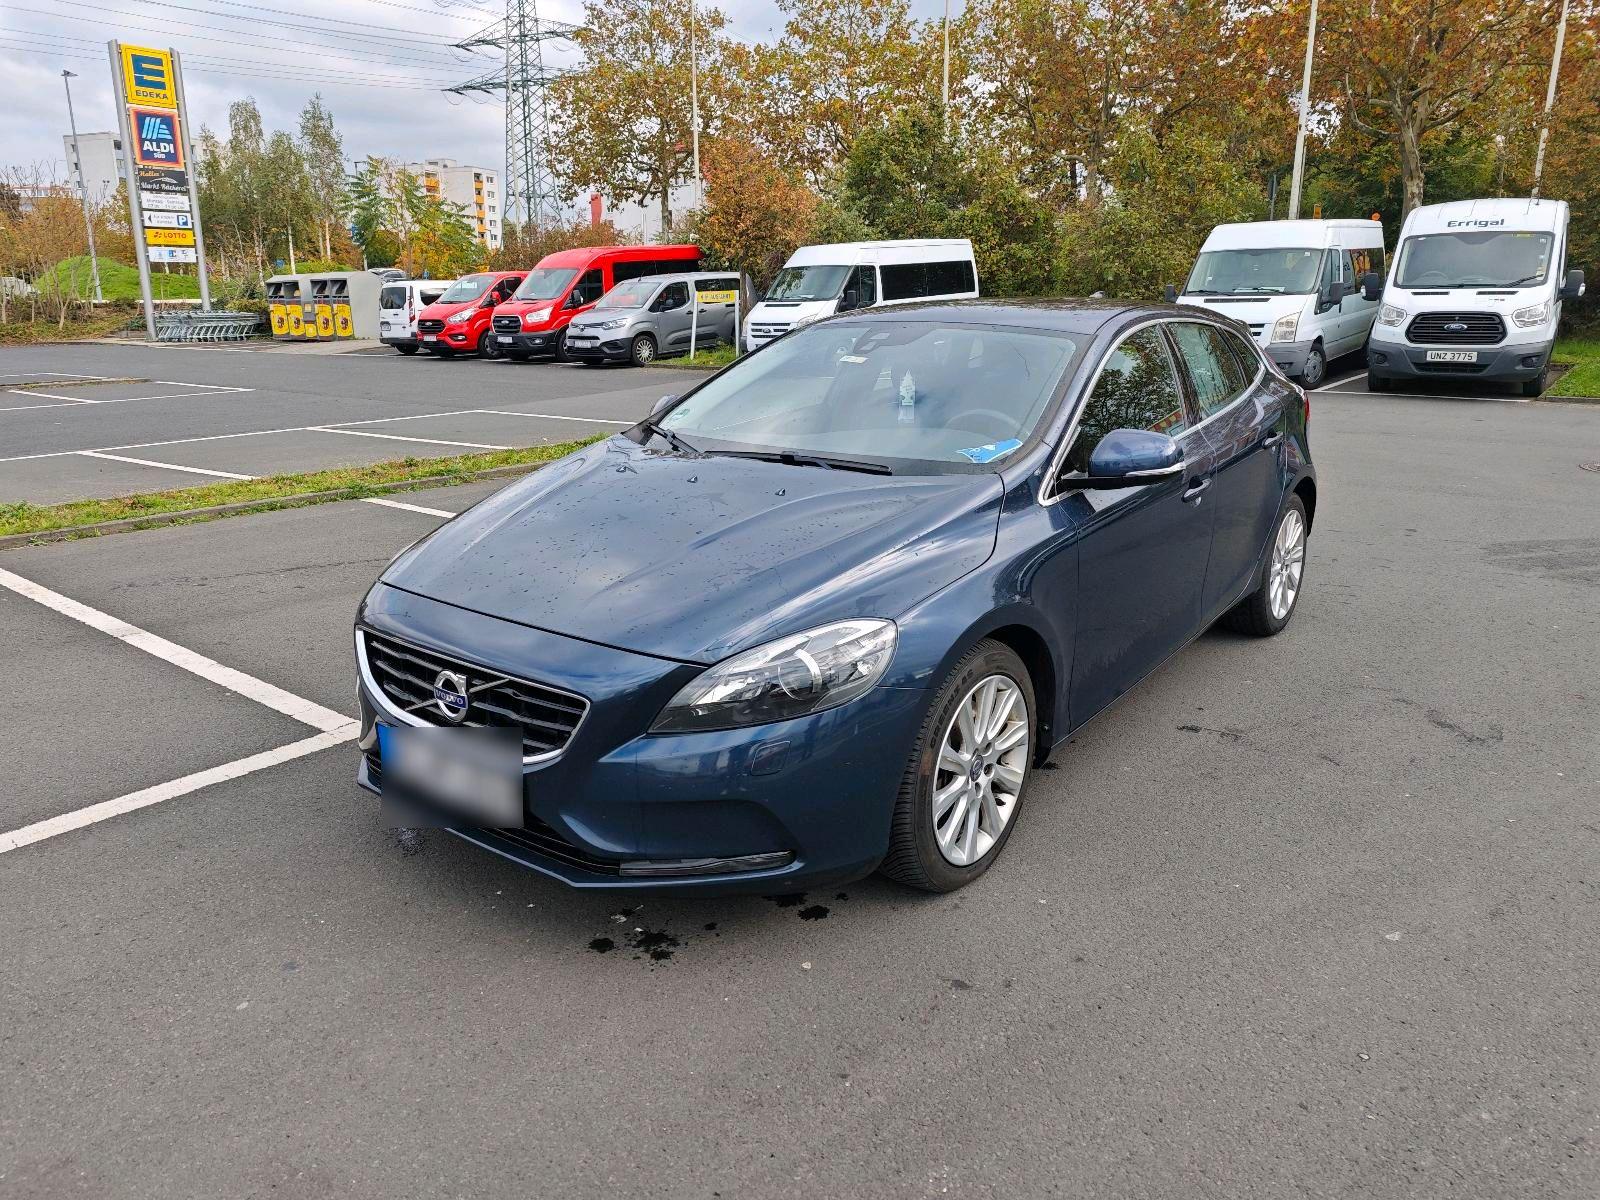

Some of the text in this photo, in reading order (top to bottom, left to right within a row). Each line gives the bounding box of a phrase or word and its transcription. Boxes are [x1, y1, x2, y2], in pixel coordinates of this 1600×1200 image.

[135, 89, 169, 100] EDEKA
[142, 140, 175, 154] ALDI
[1447, 218, 1505, 228] Errigal
[1430, 352, 1474, 361] UNZ 3775
